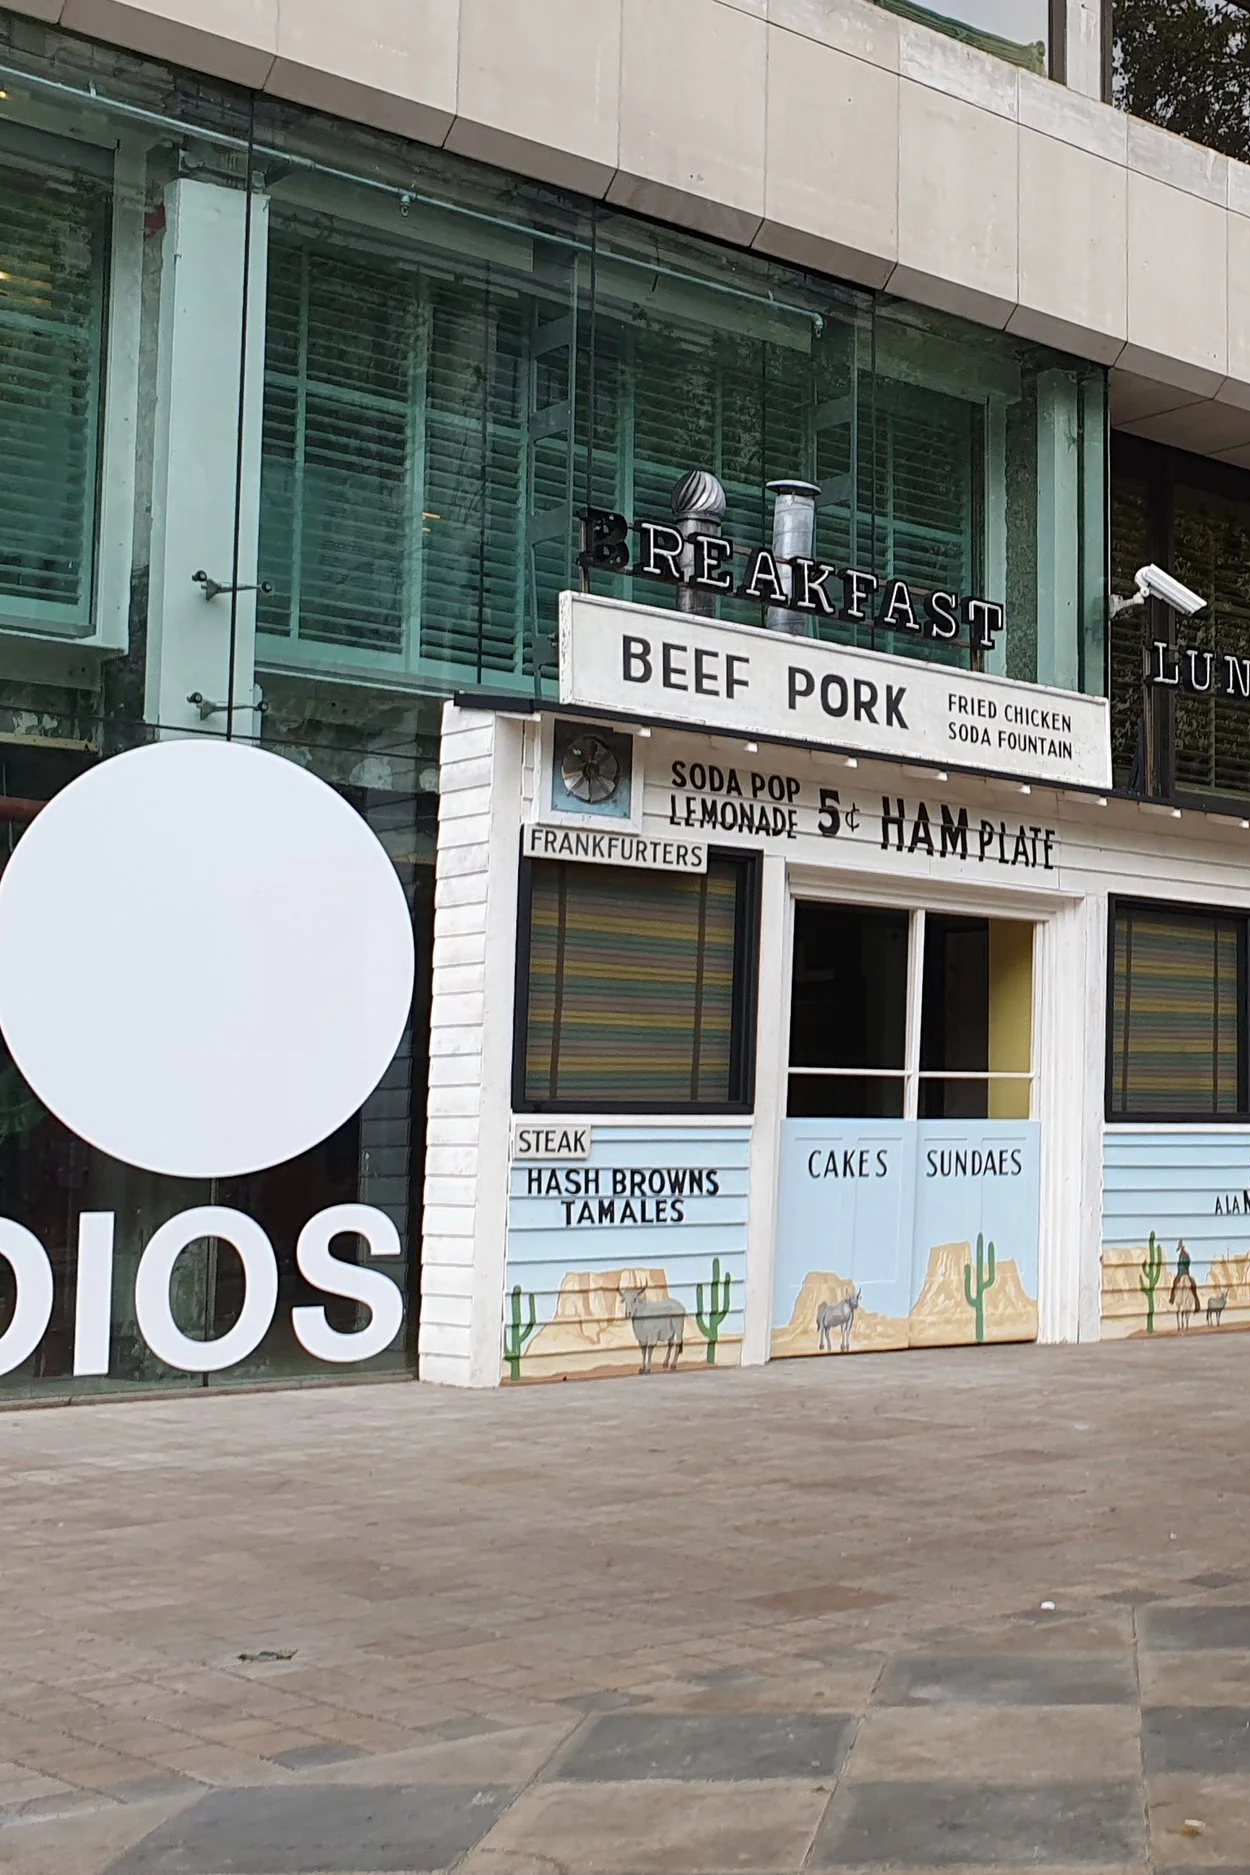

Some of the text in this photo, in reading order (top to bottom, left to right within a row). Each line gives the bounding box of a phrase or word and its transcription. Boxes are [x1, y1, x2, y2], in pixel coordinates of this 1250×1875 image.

[578, 507, 1004, 649] BREAKFAST
[621, 634, 909, 730] BEEF PORK
[947, 693, 1072, 732] FRIED CHICKEN
[948, 721, 1073, 760] SODA FOUNTAIN
[671, 760, 800, 803] SODA POP
[669, 793, 799, 841] LEMONADE
[880, 795, 1057, 870] HAM PLATE
[530, 828, 703, 868] FRANKFURTERS
[518, 1129, 587, 1155] STEAK
[808, 1149, 888, 1178] CAKES
[926, 1148, 1022, 1178] SUNDAES
[527, 1169, 719, 1197] HASH BROWNS
[561, 1198, 685, 1227] TAMALES
